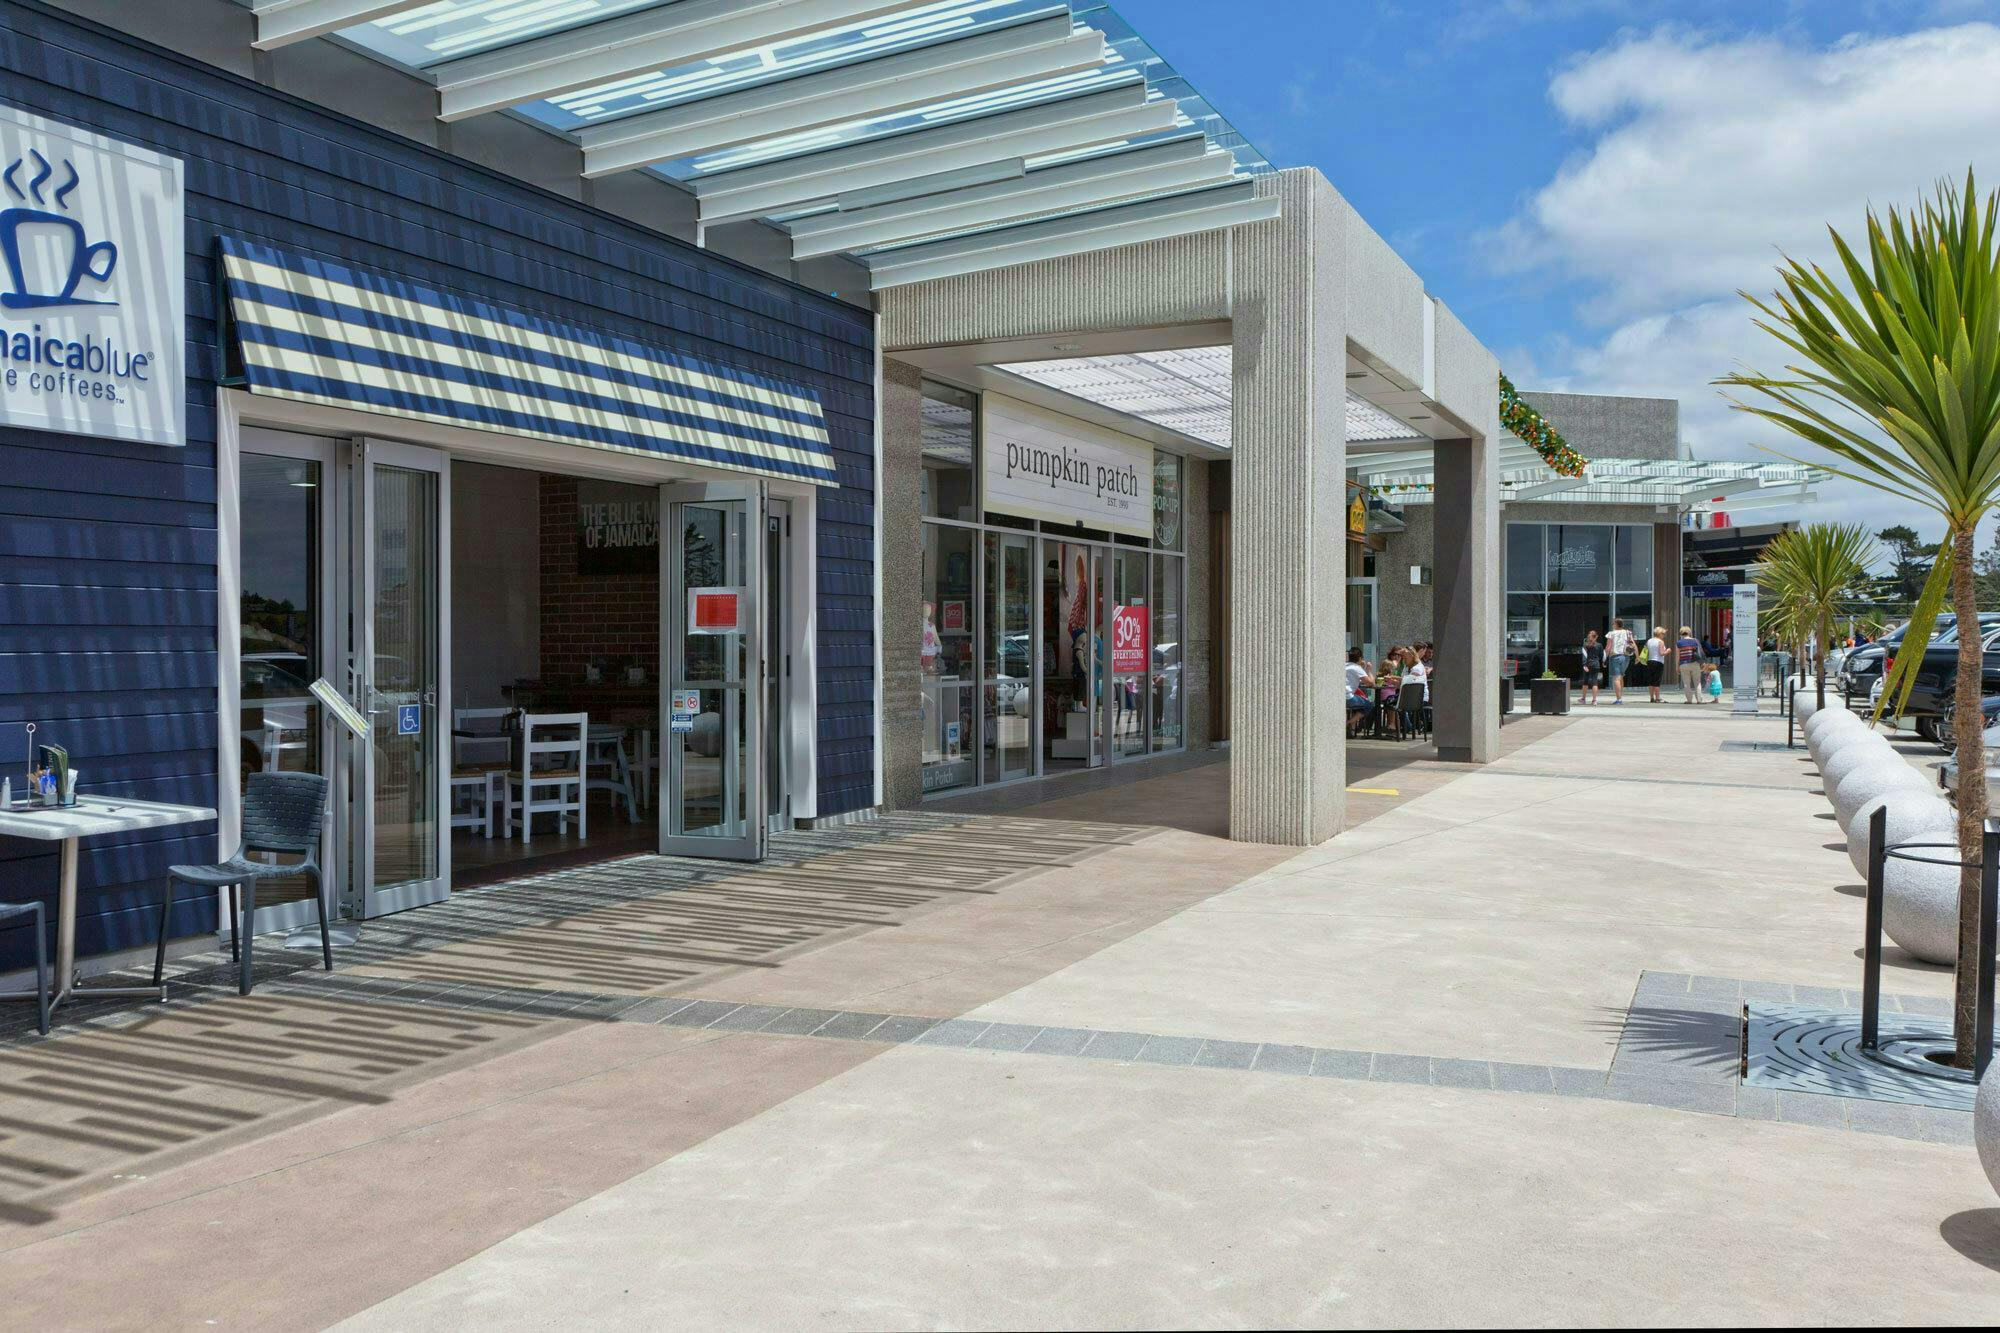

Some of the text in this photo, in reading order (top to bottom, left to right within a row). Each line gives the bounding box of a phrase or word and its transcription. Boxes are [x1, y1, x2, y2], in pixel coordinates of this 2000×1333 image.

[1006, 442, 1089, 488] pumpkin
[1096, 464, 1138, 498] patch
[581, 503, 607, 527] THE
[608, 501, 642, 525] BLUE
[585, 524, 659, 548] OF JAMAICA
[1117, 616, 1140, 647] 30%
